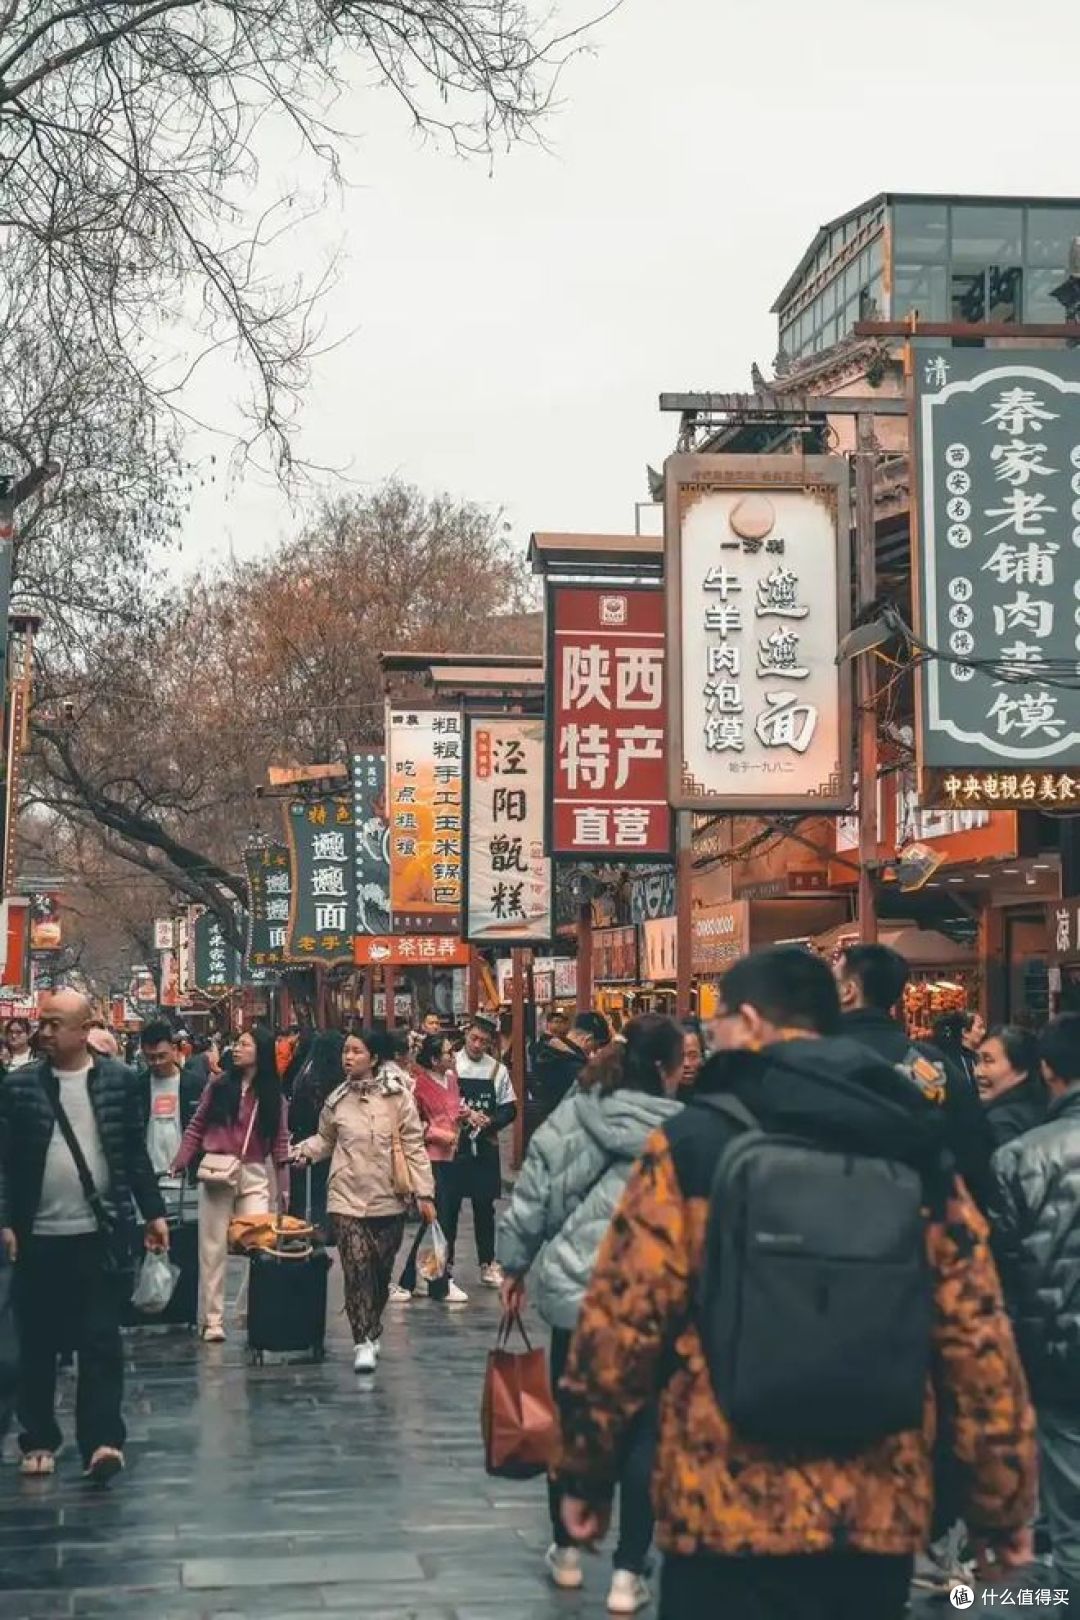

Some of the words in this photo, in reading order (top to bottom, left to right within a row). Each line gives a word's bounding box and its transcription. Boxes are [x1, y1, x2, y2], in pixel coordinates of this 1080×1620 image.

[925, 356, 949, 386] 清
[562, 644, 665, 710] 陕西
[703, 566, 744, 752] 牛羊肉泡馍
[559, 723, 665, 790] 特产
[944, 774, 1080, 800] 中央电视台美食
[395, 760, 416, 856] 吃点粗粮
[432, 717, 461, 904] 粗粮手工玉米锅巴
[490, 738, 528, 918] 泾阳甑糕
[572, 808, 650, 846] 直营
